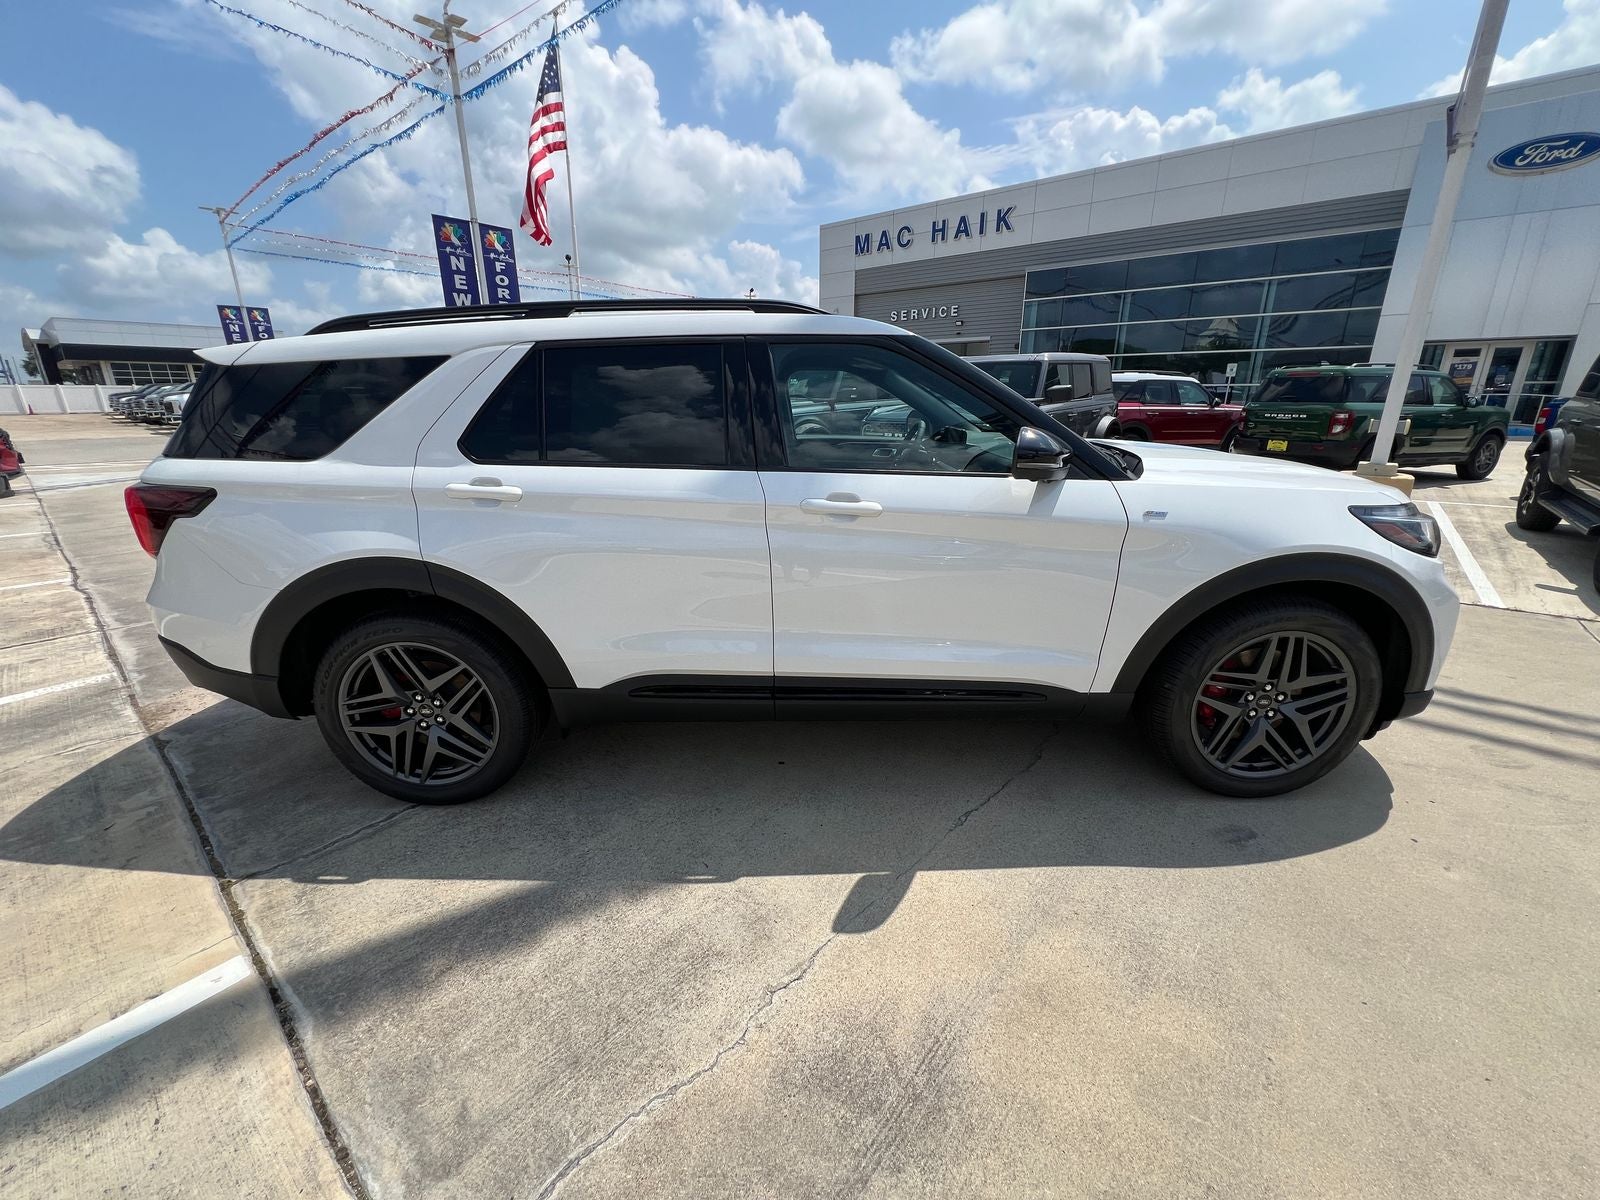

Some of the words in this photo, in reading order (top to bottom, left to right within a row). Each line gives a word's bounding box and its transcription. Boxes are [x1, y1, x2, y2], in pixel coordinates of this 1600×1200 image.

[1515, 140, 1586, 166] Ford
[854, 225, 913, 256] MAC
[931, 206, 1016, 243] HAIK
[449, 255, 472, 307] NEW
[494, 261, 512, 304] FOR
[890, 305, 959, 322] SERVICE
[228, 324, 242, 342] NE
